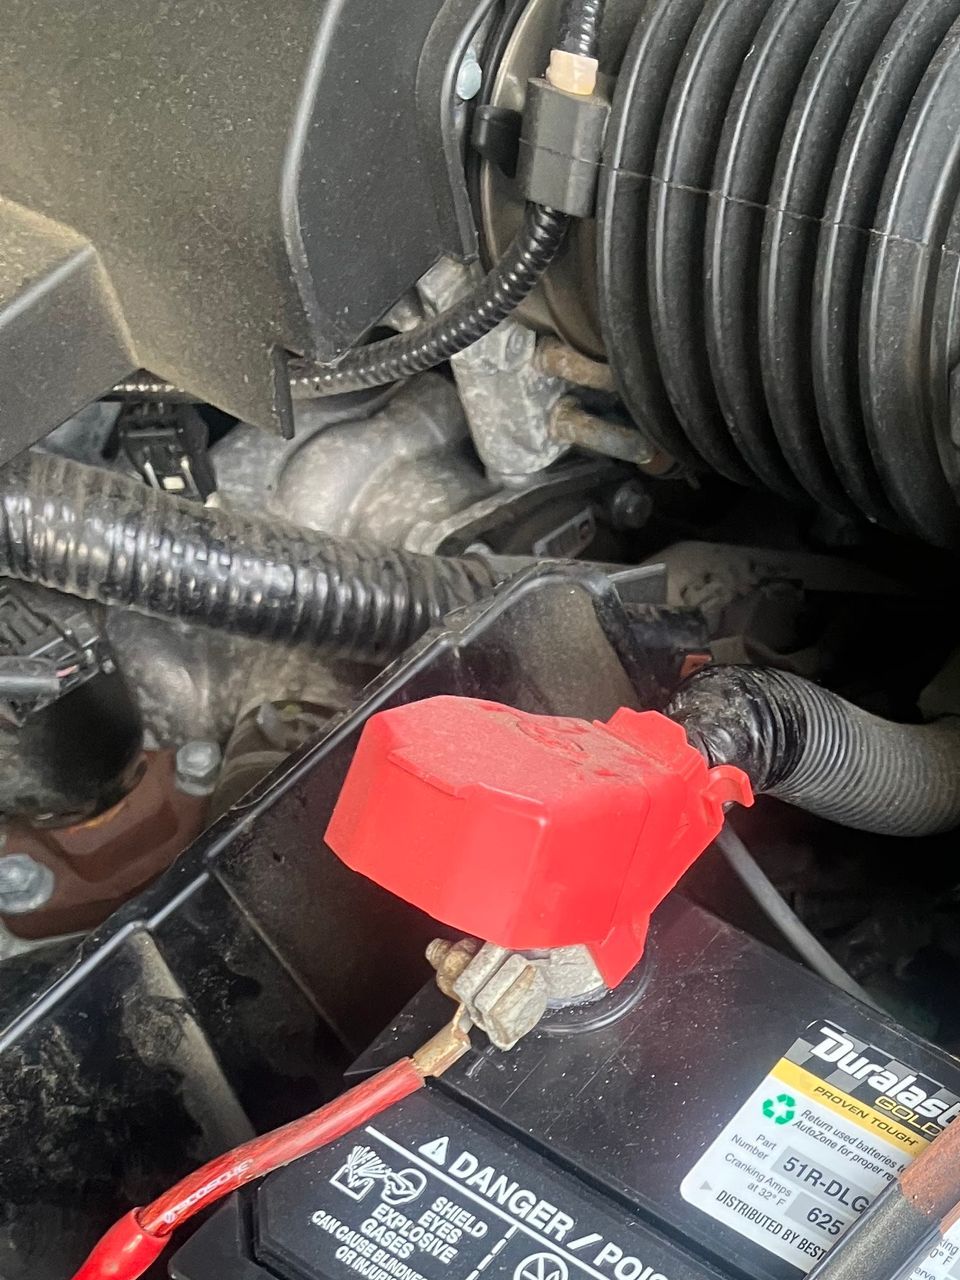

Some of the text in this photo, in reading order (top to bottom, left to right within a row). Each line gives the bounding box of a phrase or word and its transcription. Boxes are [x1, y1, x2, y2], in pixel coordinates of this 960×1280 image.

[800, 1108, 834, 1133] Return
[832, 1128, 857, 1145] used
[854, 1139, 898, 1169] batteries
[871, 1091, 942, 1141] GOLD
[730, 1133, 769, 1160] Number
[755, 1133, 777, 1151] Part
[791, 1119, 838, 1149] AutoZone
[836, 1143, 854, 1158] for
[849, 1153, 885, 1176] proper
[723, 1151, 792, 1198] Cranking Amps
[746, 1181, 759, 1193] at
[775, 1197, 787, 1207] F
[782, 1155, 871, 1217] 51R-DLG
[430, 1195, 489, 1239] SHIELD
[447, 1149, 575, 1243] DANGER
[566, 1232, 603, 1250] /
[805, 1206, 845, 1236] 625
[310, 1209, 342, 1234] CAN
[334, 1224, 378, 1258] CAUSE
[359, 1216, 415, 1259] GASES
[370, 1201, 459, 1264] EXPLOSIVE
[416, 1208, 463, 1245] EYES
[714, 1189, 827, 1263] DISTRIBUTED BY BEST
[334, 1244, 358, 1265] OR
[941, 1254, 953, 1266] F
